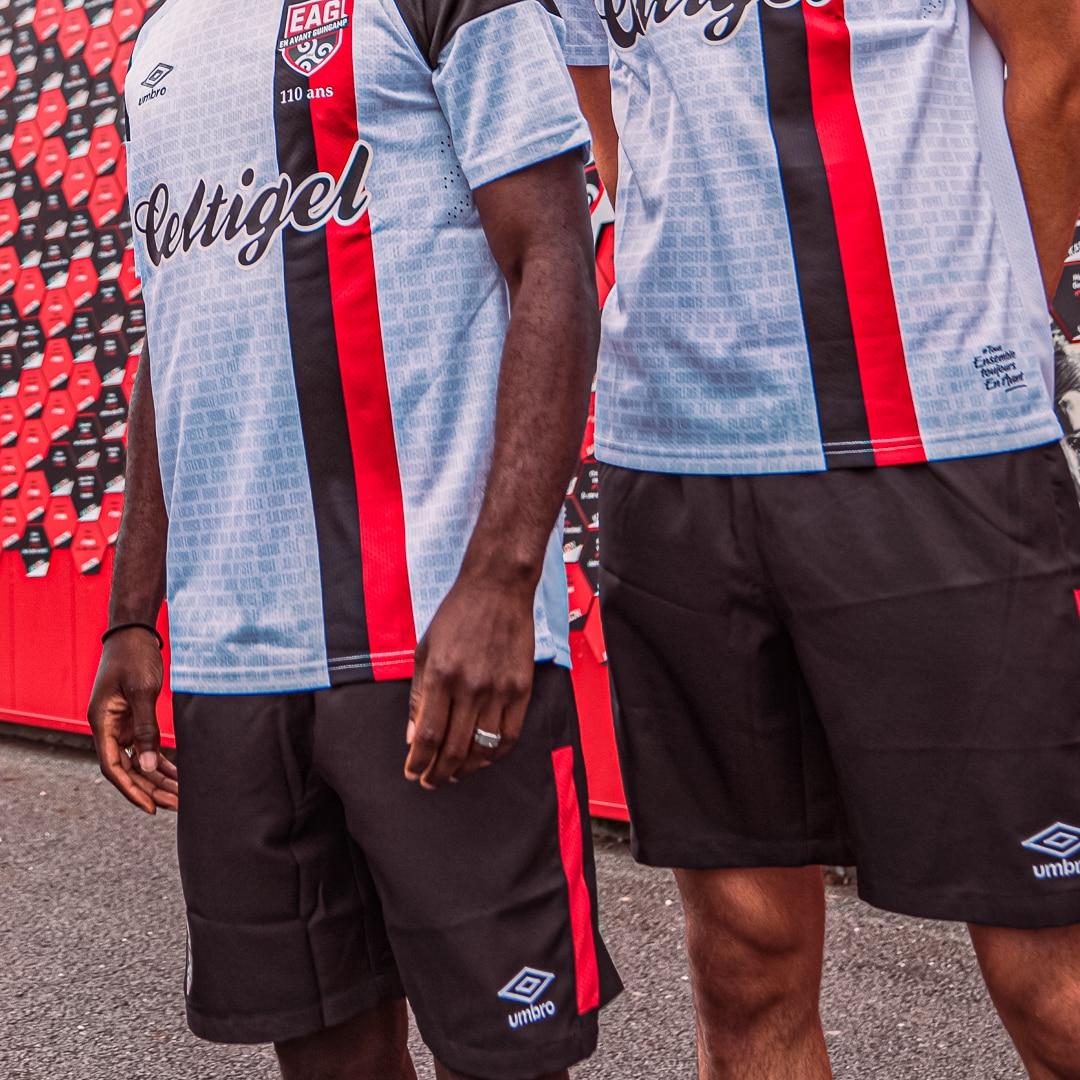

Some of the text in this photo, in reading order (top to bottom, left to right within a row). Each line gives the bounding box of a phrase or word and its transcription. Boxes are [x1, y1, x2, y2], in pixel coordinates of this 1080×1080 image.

[290, 0, 340, 33] EAG
[280, 18, 348, 48] EN AVANT GUINGAMP
[138, 86, 166, 106] umbro
[280, 86, 334, 104] 110 ans
[133, 139, 373, 270] Celtigel
[1032, 858, 1080, 879] umbr
[508, 1000, 556, 1028] umbro
